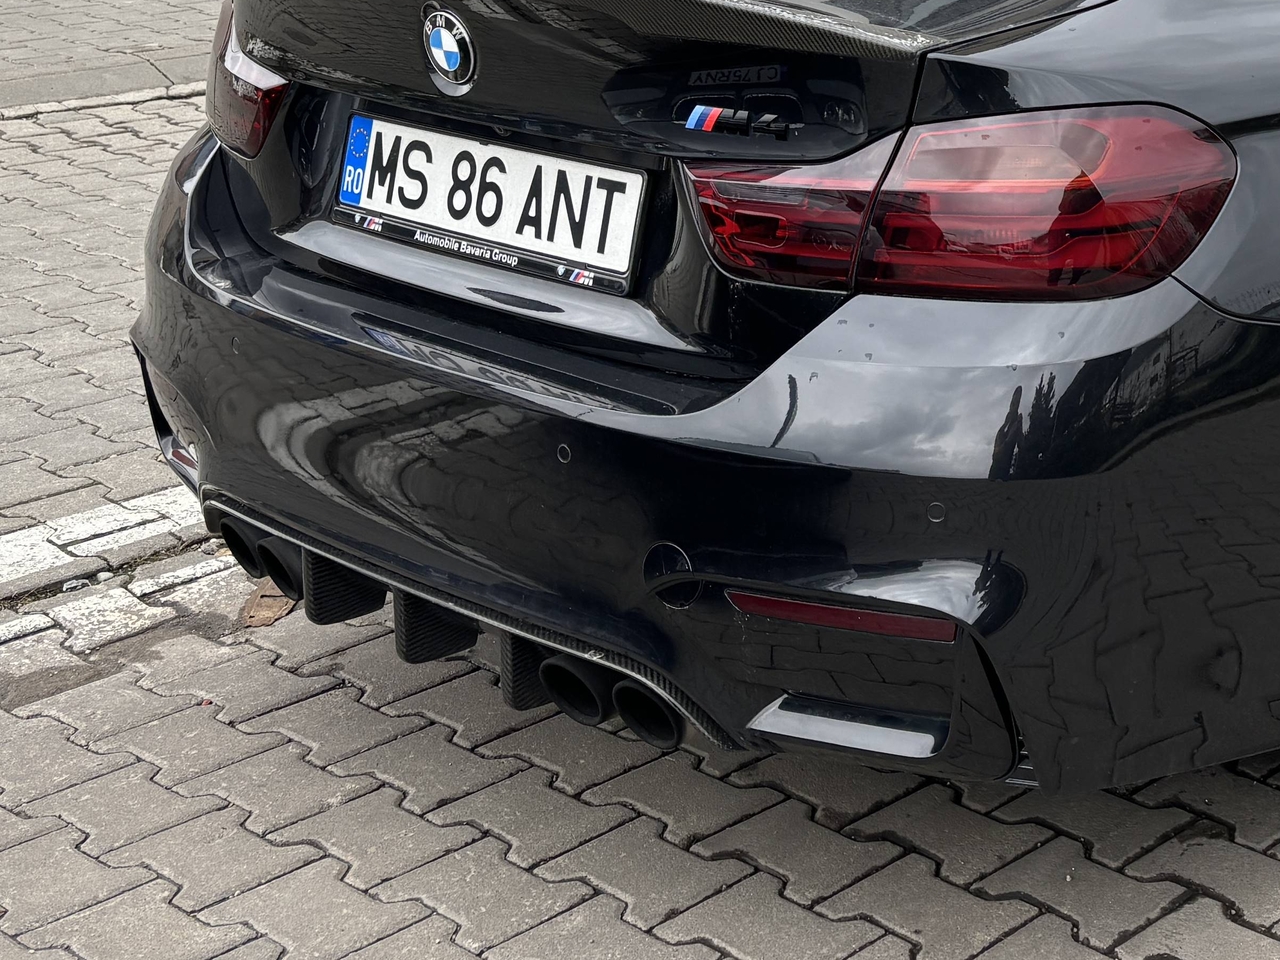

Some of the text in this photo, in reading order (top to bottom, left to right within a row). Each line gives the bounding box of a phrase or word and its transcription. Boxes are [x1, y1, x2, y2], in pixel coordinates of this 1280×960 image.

[425, 14, 465, 41] BMW
[685, 104, 790, 141] M4
[343, 165, 363, 195] RO
[366, 131, 628, 255] MS 86 ANT
[413, 229, 519, 268] Automobile Bavaria Group
